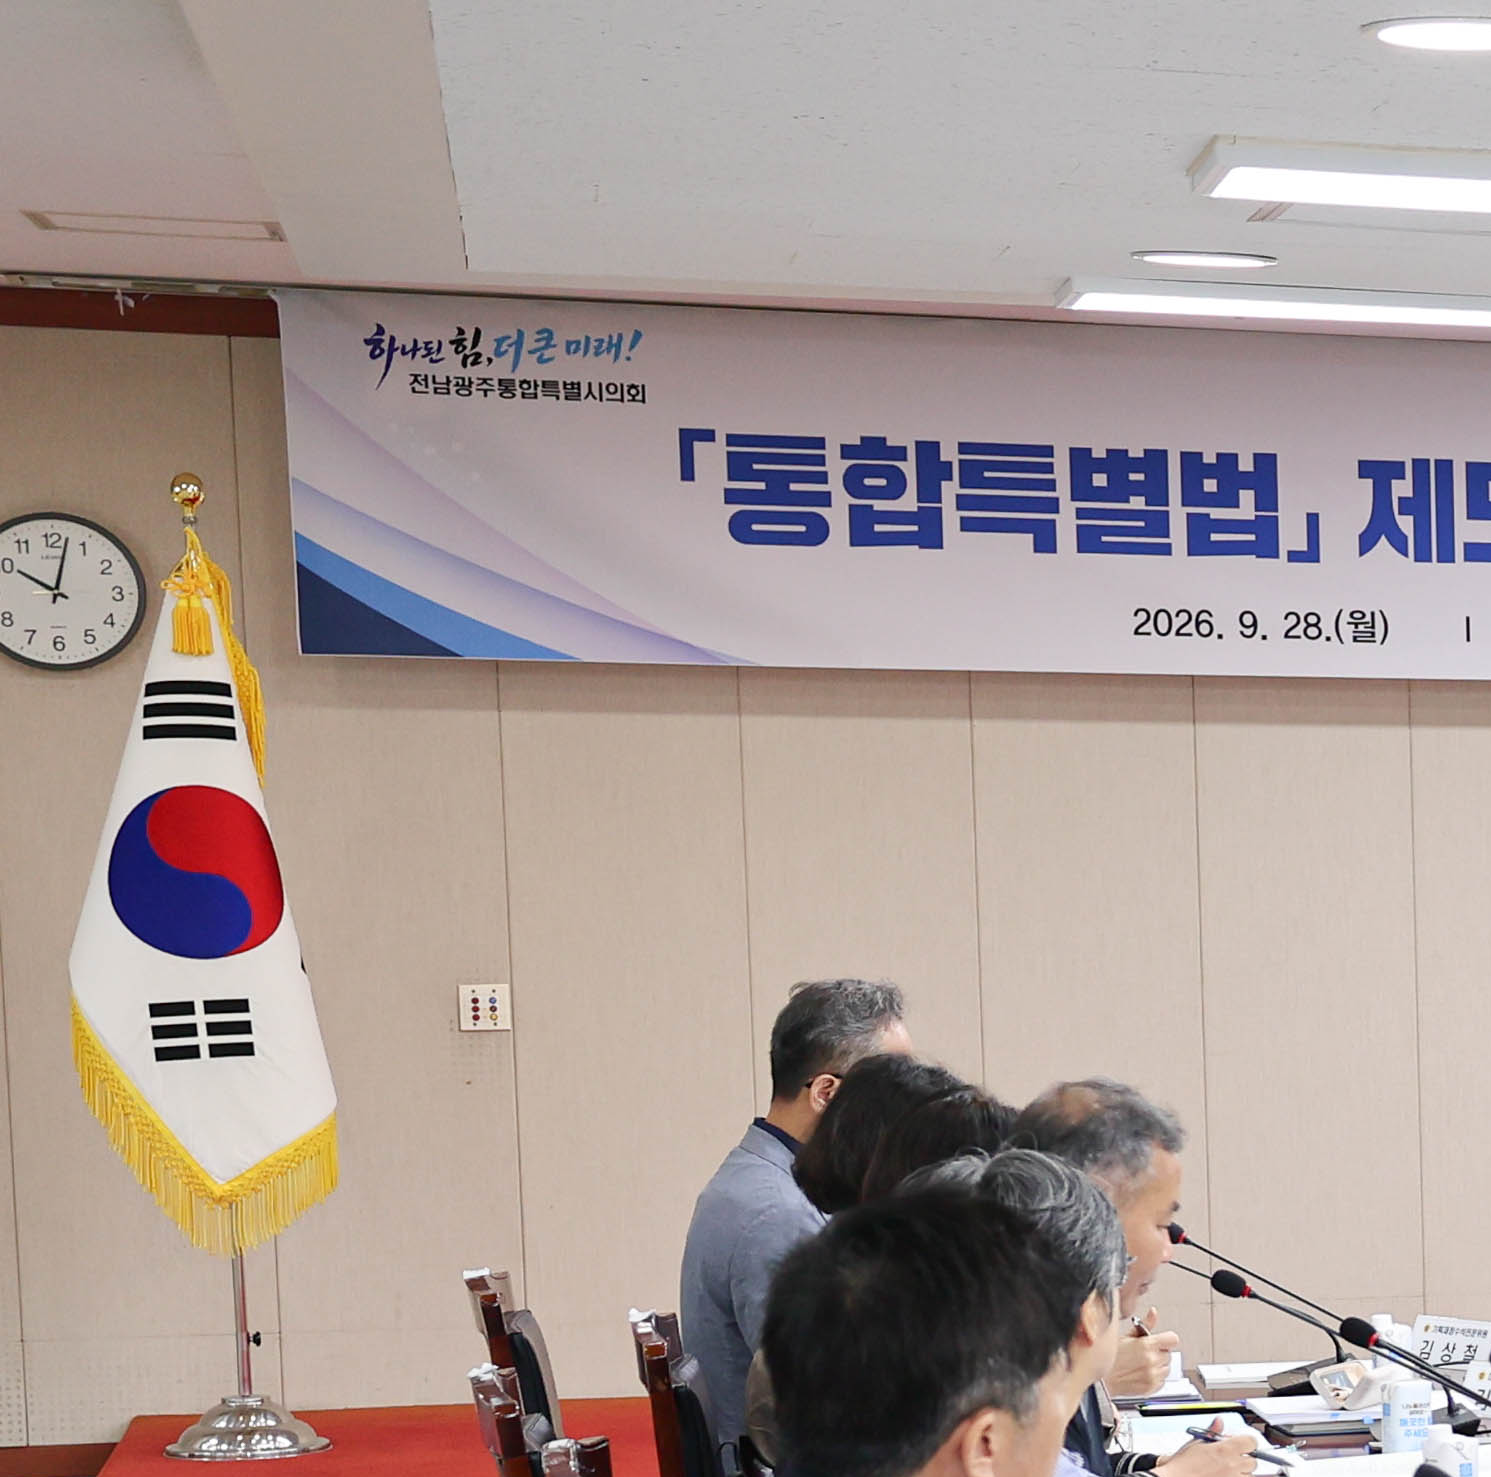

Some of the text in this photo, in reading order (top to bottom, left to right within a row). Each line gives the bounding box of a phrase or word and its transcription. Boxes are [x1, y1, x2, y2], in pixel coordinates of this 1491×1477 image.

[363, 322, 445, 390] 하나된
[493, 328, 525, 373] 더
[528, 327, 557, 364] 큰
[565, 329, 643, 363] 미래!
[409, 372, 647, 404] 전남광주통합특별시의회
[679, 428, 1320, 563] 「통합특별법」
[14, 539, 30, 554] 11
[42, 532, 62, 549] 12
[79, 541, 87, 556] 1
[100, 559, 113, 575] 2
[112, 585, 125, 602] 3
[1, 611, 14, 627] 8
[103, 613, 116, 628] 4
[1132, 608, 1224, 640] 2026.
[1238, 611, 1268, 641] 9.
[24, 629, 37, 645] 7
[53, 635, 66, 652] 6
[83, 629, 97, 645] 5
